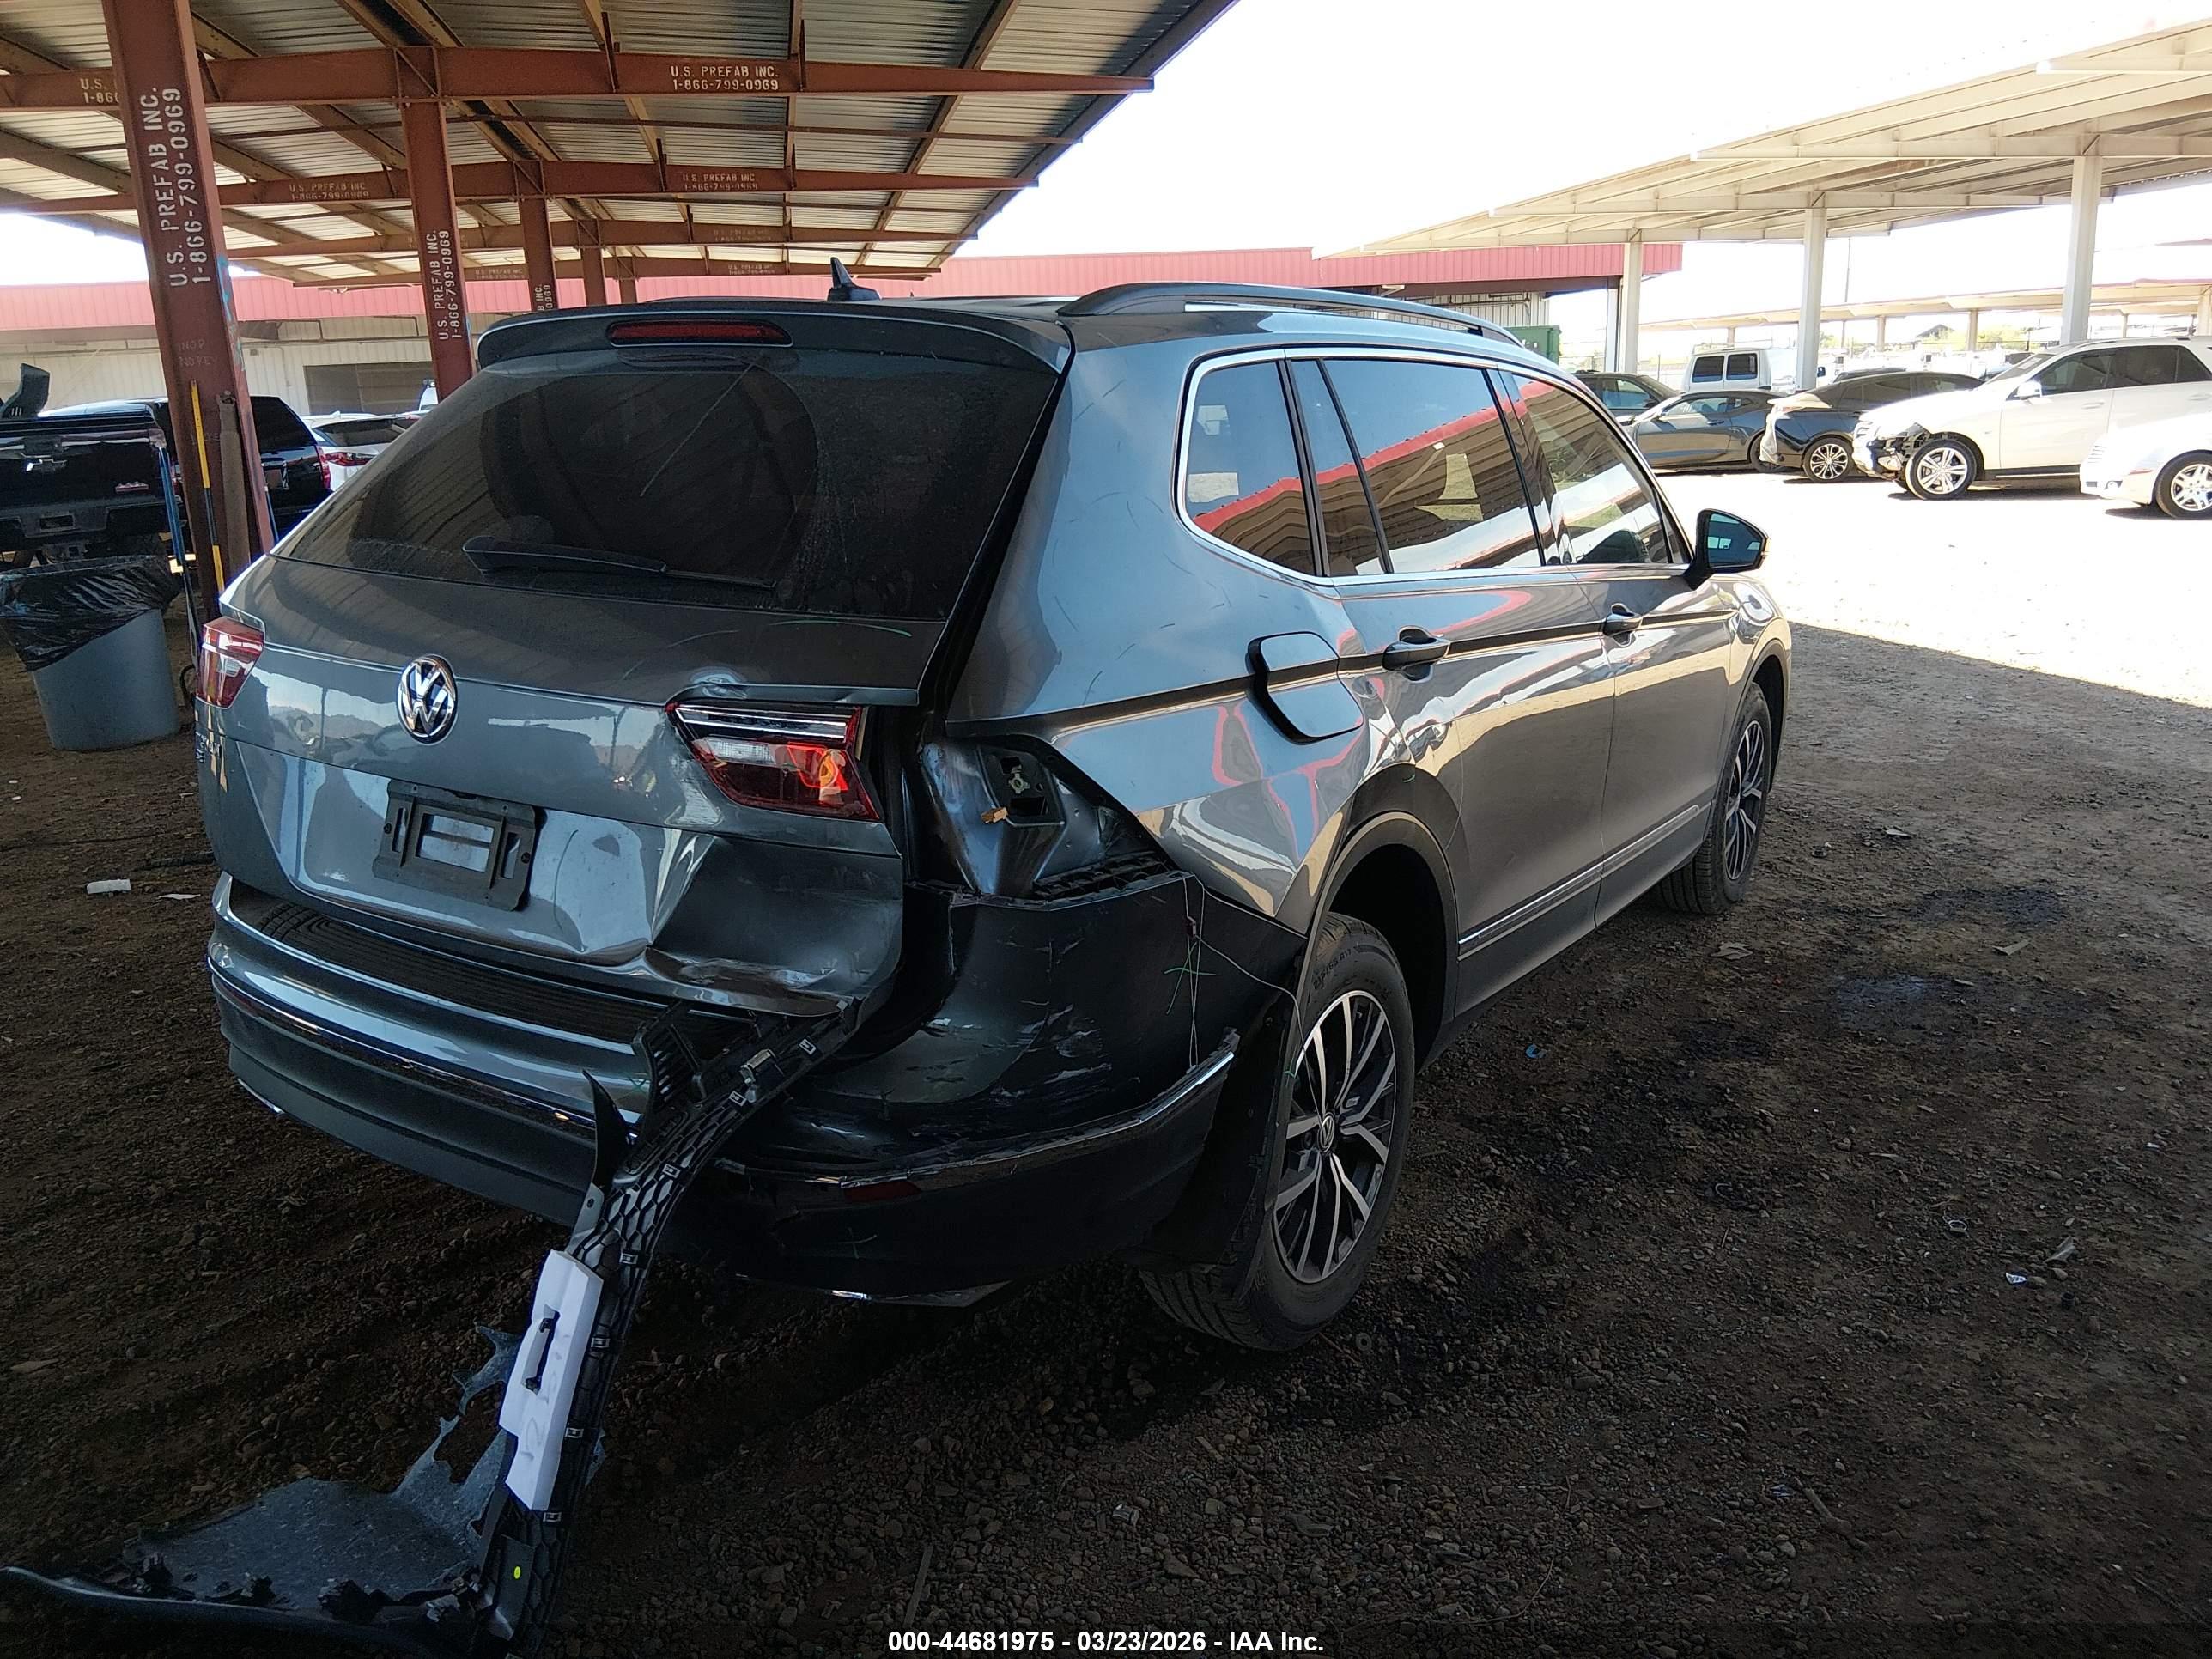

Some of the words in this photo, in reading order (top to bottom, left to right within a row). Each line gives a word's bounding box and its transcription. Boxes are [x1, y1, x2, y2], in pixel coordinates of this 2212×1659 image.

[80, 78, 107, 90] U.S.
[671, 65, 695, 77] U.S.
[702, 65, 750, 77] PREFAB
[756, 65, 779, 77] INC.
[673, 79, 779, 91] 1-866-799-0969
[140, 88, 163, 131] INC.
[148, 143, 179, 231] PREFAB
[162, 88, 211, 283] 1-866-799-0969
[426, 229, 439, 254] INC.
[166, 245, 188, 287] U.S.
[429, 260, 446, 309] PREFAB
[438, 230, 463, 339] 1-866-799-0969
[437, 316, 449, 340] U.S.
